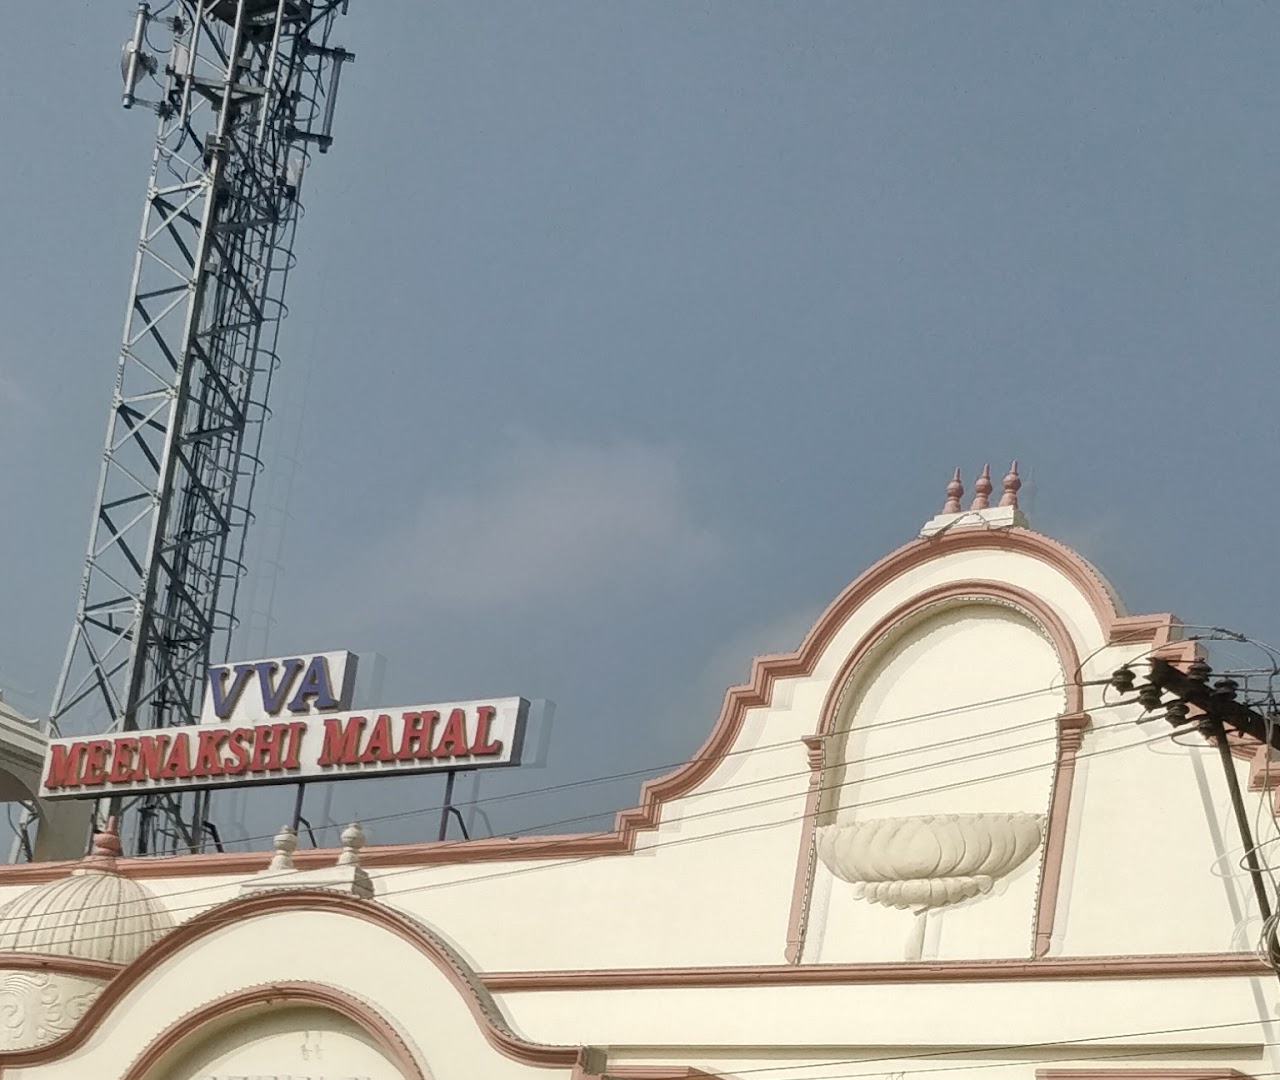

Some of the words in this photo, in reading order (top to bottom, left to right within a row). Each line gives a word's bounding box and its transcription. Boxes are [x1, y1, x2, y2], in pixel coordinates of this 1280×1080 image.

[208, 656, 340, 720] VVA
[44, 721, 307, 789] MEENAKSHI
[318, 705, 503, 768] MAHAL
